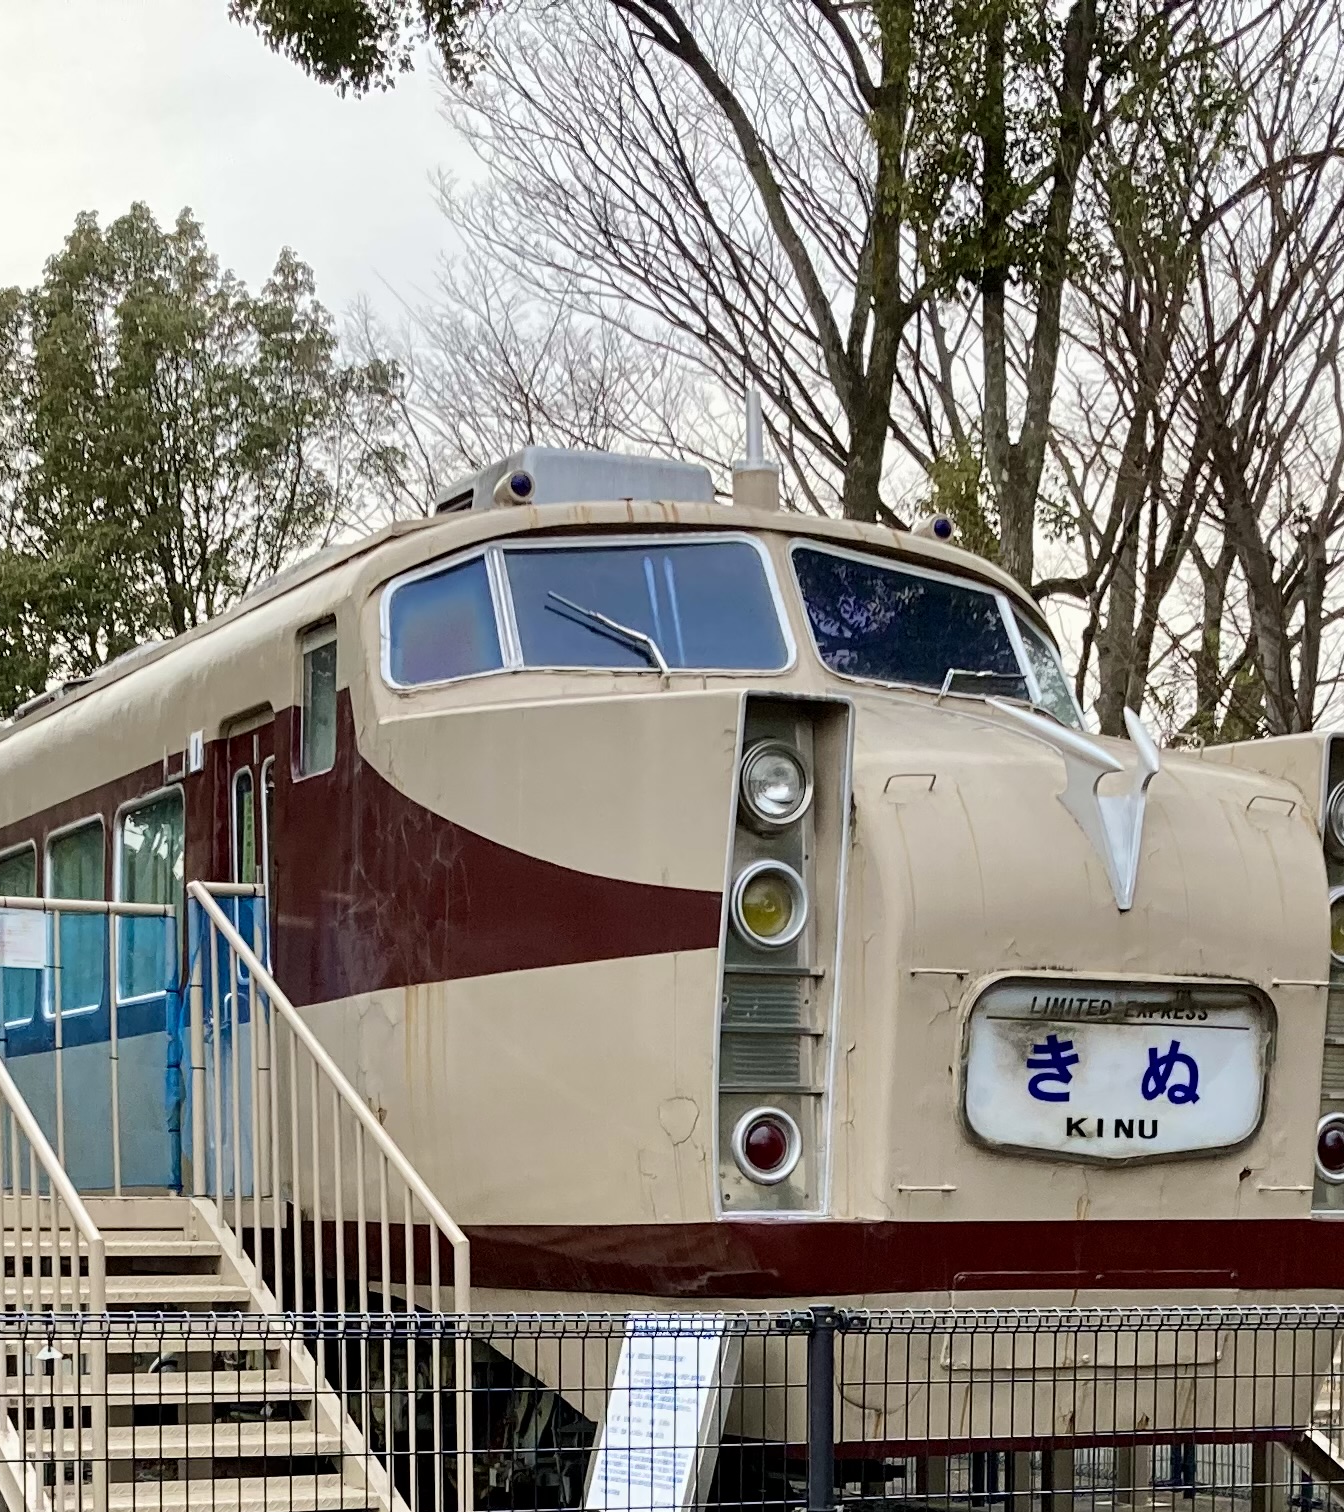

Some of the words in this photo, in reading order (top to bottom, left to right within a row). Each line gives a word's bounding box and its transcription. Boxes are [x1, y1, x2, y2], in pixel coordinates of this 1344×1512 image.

[1030, 996, 1112, 1016] LIMITED
[1123, 1000, 1208, 1021] EXPRESS
[1026, 1034, 1200, 1105] きぬ
[1066, 1117, 1159, 1139] KINU
